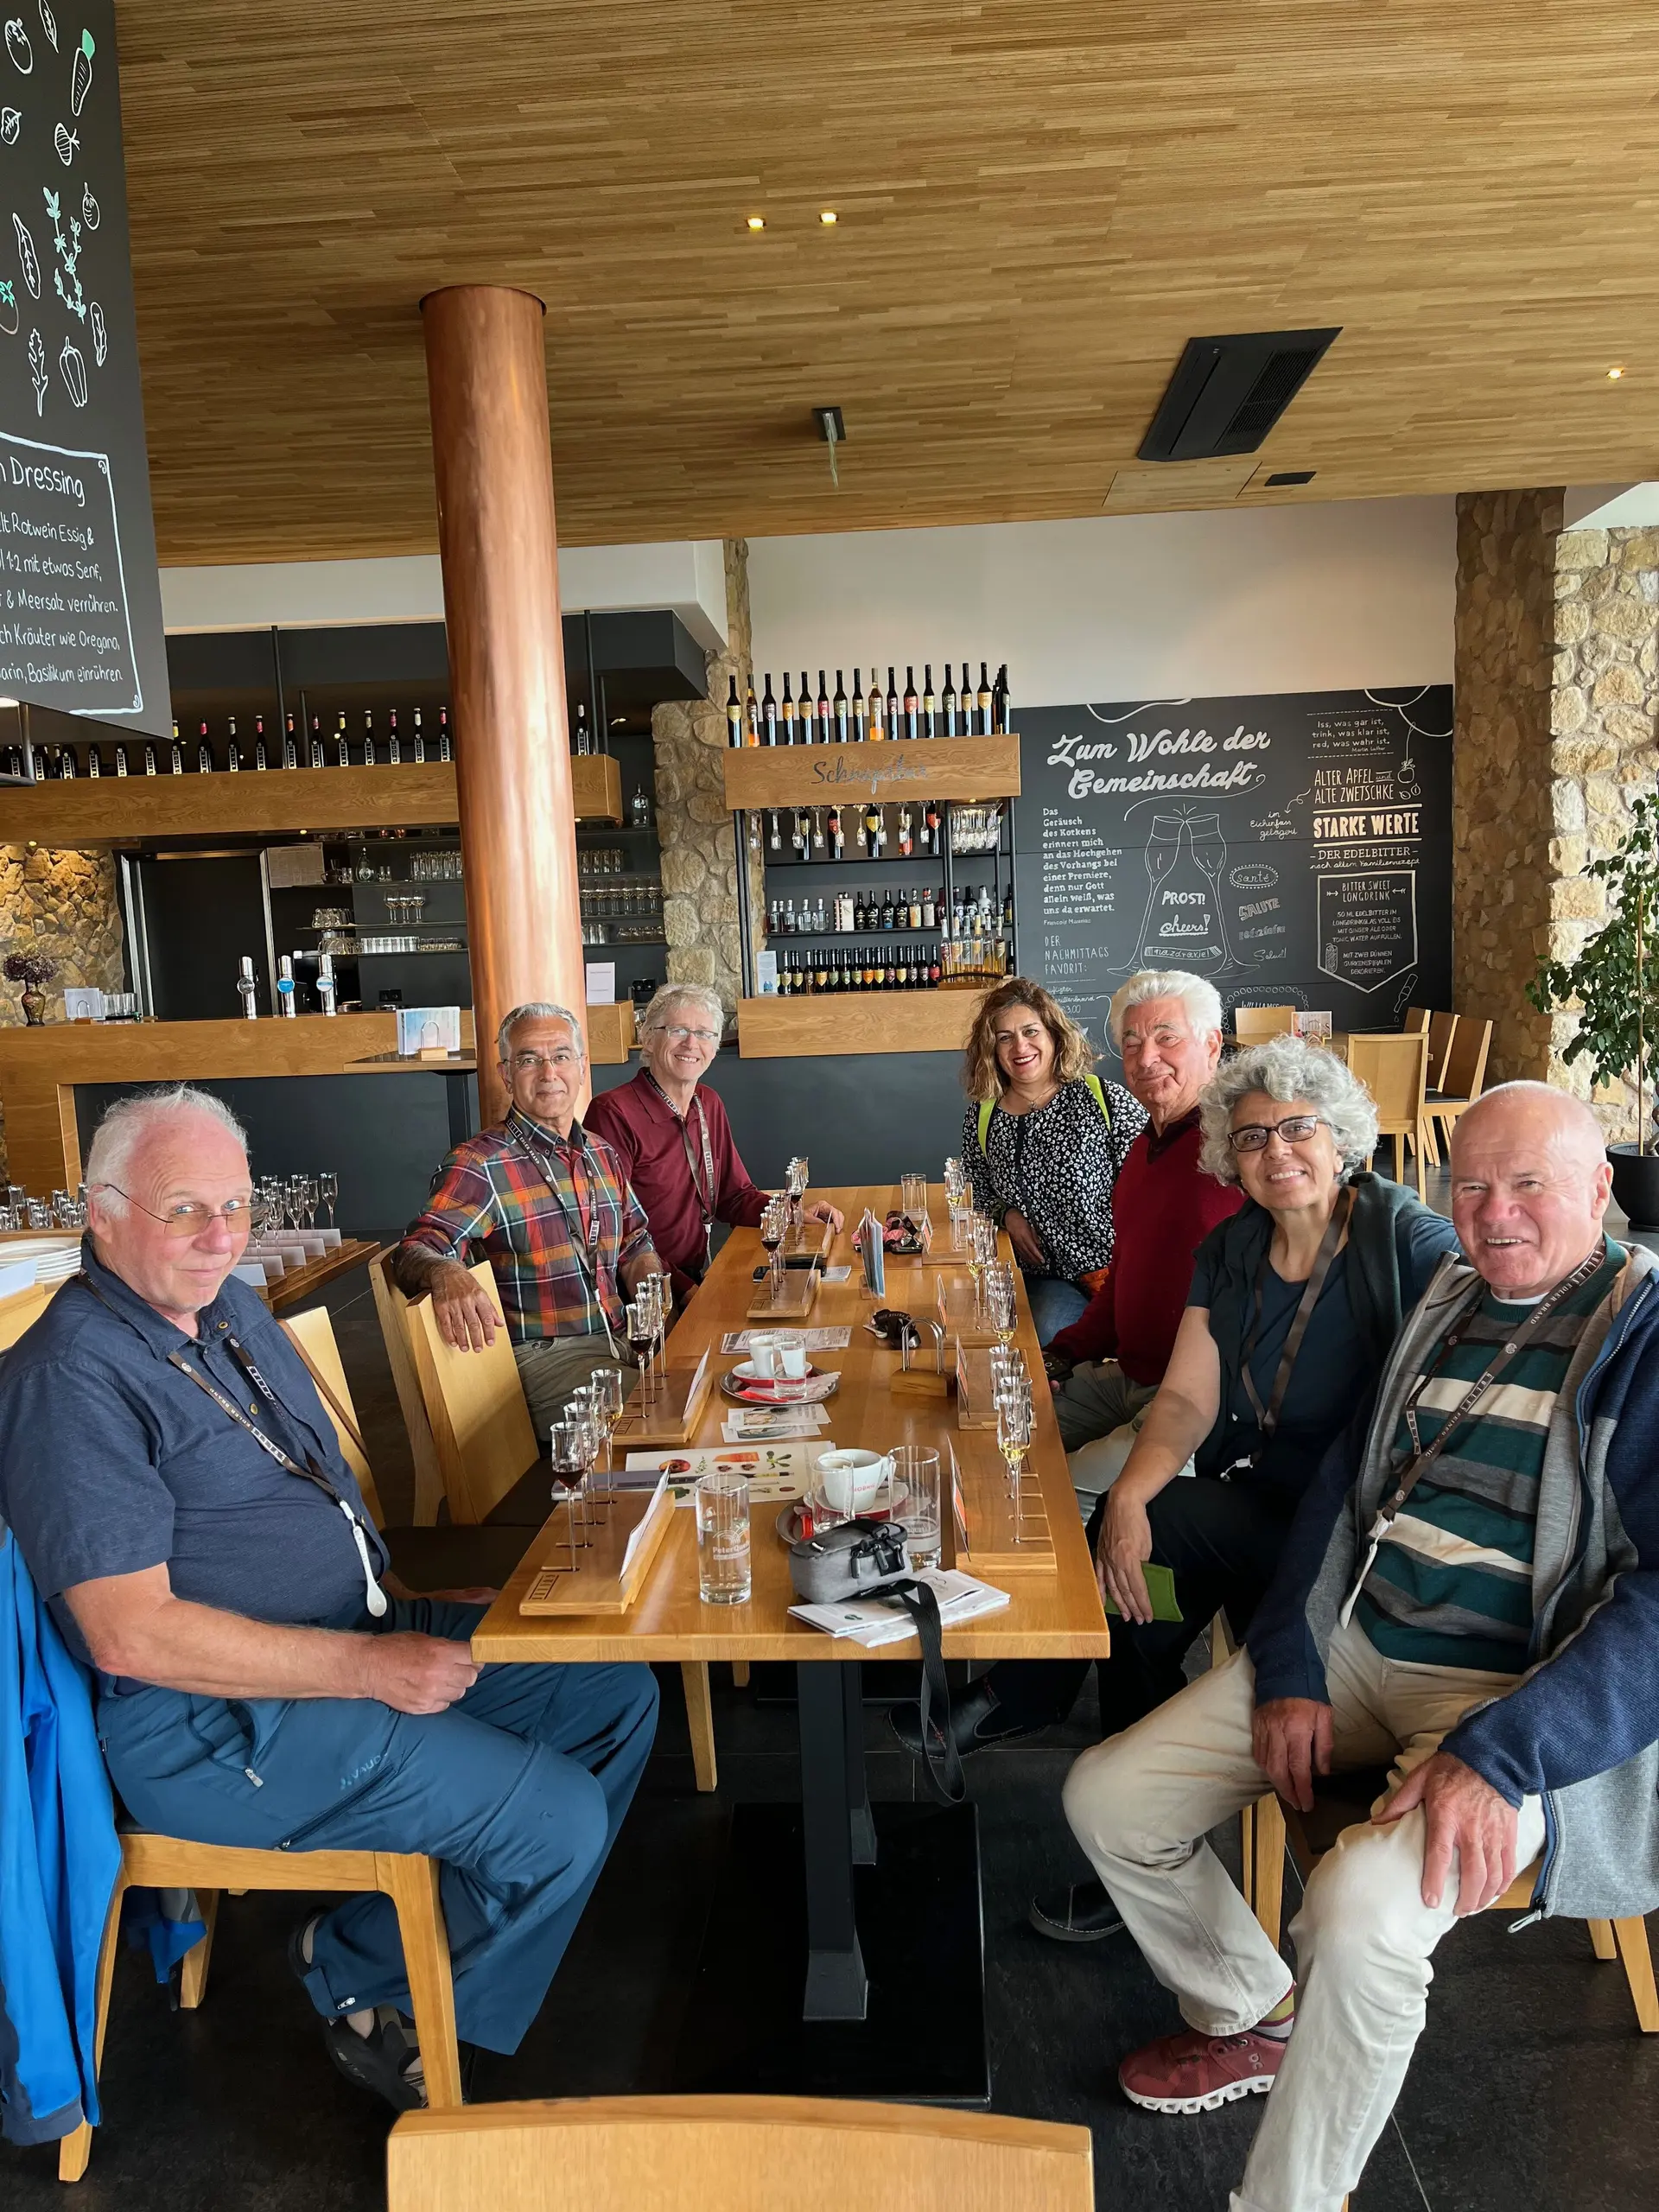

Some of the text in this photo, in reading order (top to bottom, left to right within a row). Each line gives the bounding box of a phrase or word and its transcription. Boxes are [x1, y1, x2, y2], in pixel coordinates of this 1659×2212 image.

[10, 455, 85, 507] Dressing
[11, 512, 58, 540] Rotwein
[59, 524, 87, 551] Essig
[86, 527, 94, 545] &
[6, 550, 22, 572] 1:2
[23, 554, 41, 573] mit
[42, 556, 75, 577] etwas
[75, 560, 103, 582] Senf,
[6, 588, 119, 613] & Meersalz verrühren.
[13, 623, 57, 646] Kräuter
[60, 632, 77, 647] wie
[79, 630, 120, 656] Oregano,
[27, 662, 75, 683] Basilikum
[1354, 719, 1368, 728] gar
[1046, 725, 1271, 767] Zum Wohle der
[1067, 760, 1258, 799] Gemeinschaft
[1314, 769, 1342, 786] ALTER
[1346, 767, 1374, 785] APFEL
[1314, 784, 1394, 804] ALTE ZWETSCHKE
[1043, 816, 1083, 827] Geräusch
[1249, 818, 1292, 830] Eichenfass
[1313, 812, 1420, 839] STARKE WERTE
[1059, 828, 1096, 836] Korkens
[1259, 828, 1298, 841] gelagert
[1081, 837, 1104, 847] mich
[1056, 850, 1071, 859] das
[1073, 848, 1122, 858] Hochgehen
[1318, 846, 1411, 861] DER EDELBITTER
[1059, 861, 1102, 870] Vorhangs
[1103, 858, 1118, 867] bei
[1309, 861, 1332, 869] nach
[1043, 871, 1112, 881] einer Premiere,
[1236, 870, 1270, 882] santé
[1043, 884, 1065, 893] denn
[1085, 881, 1104, 891] Gott
[1342, 880, 1391, 892] BITTER SWEET
[1043, 894, 1068, 903] allein
[1070, 893, 1095, 903] weiß,
[1161, 890, 1206, 906] PROST!
[1343, 891, 1390, 903] LONGDRINK
[1074, 904, 1115, 913] erwartet.
[1160, 913, 1211, 933] cheers!
[1045, 935, 1061, 947] DER
[1045, 946, 1109, 961] NACHMITTAGS
[1045, 963, 1087, 975] FAVORIT:
[1530, 1282, 1573, 1325] EDLER BRAND
[231, 1408, 251, 1427] EDLER
[351, 1752, 387, 1778] VAUD
